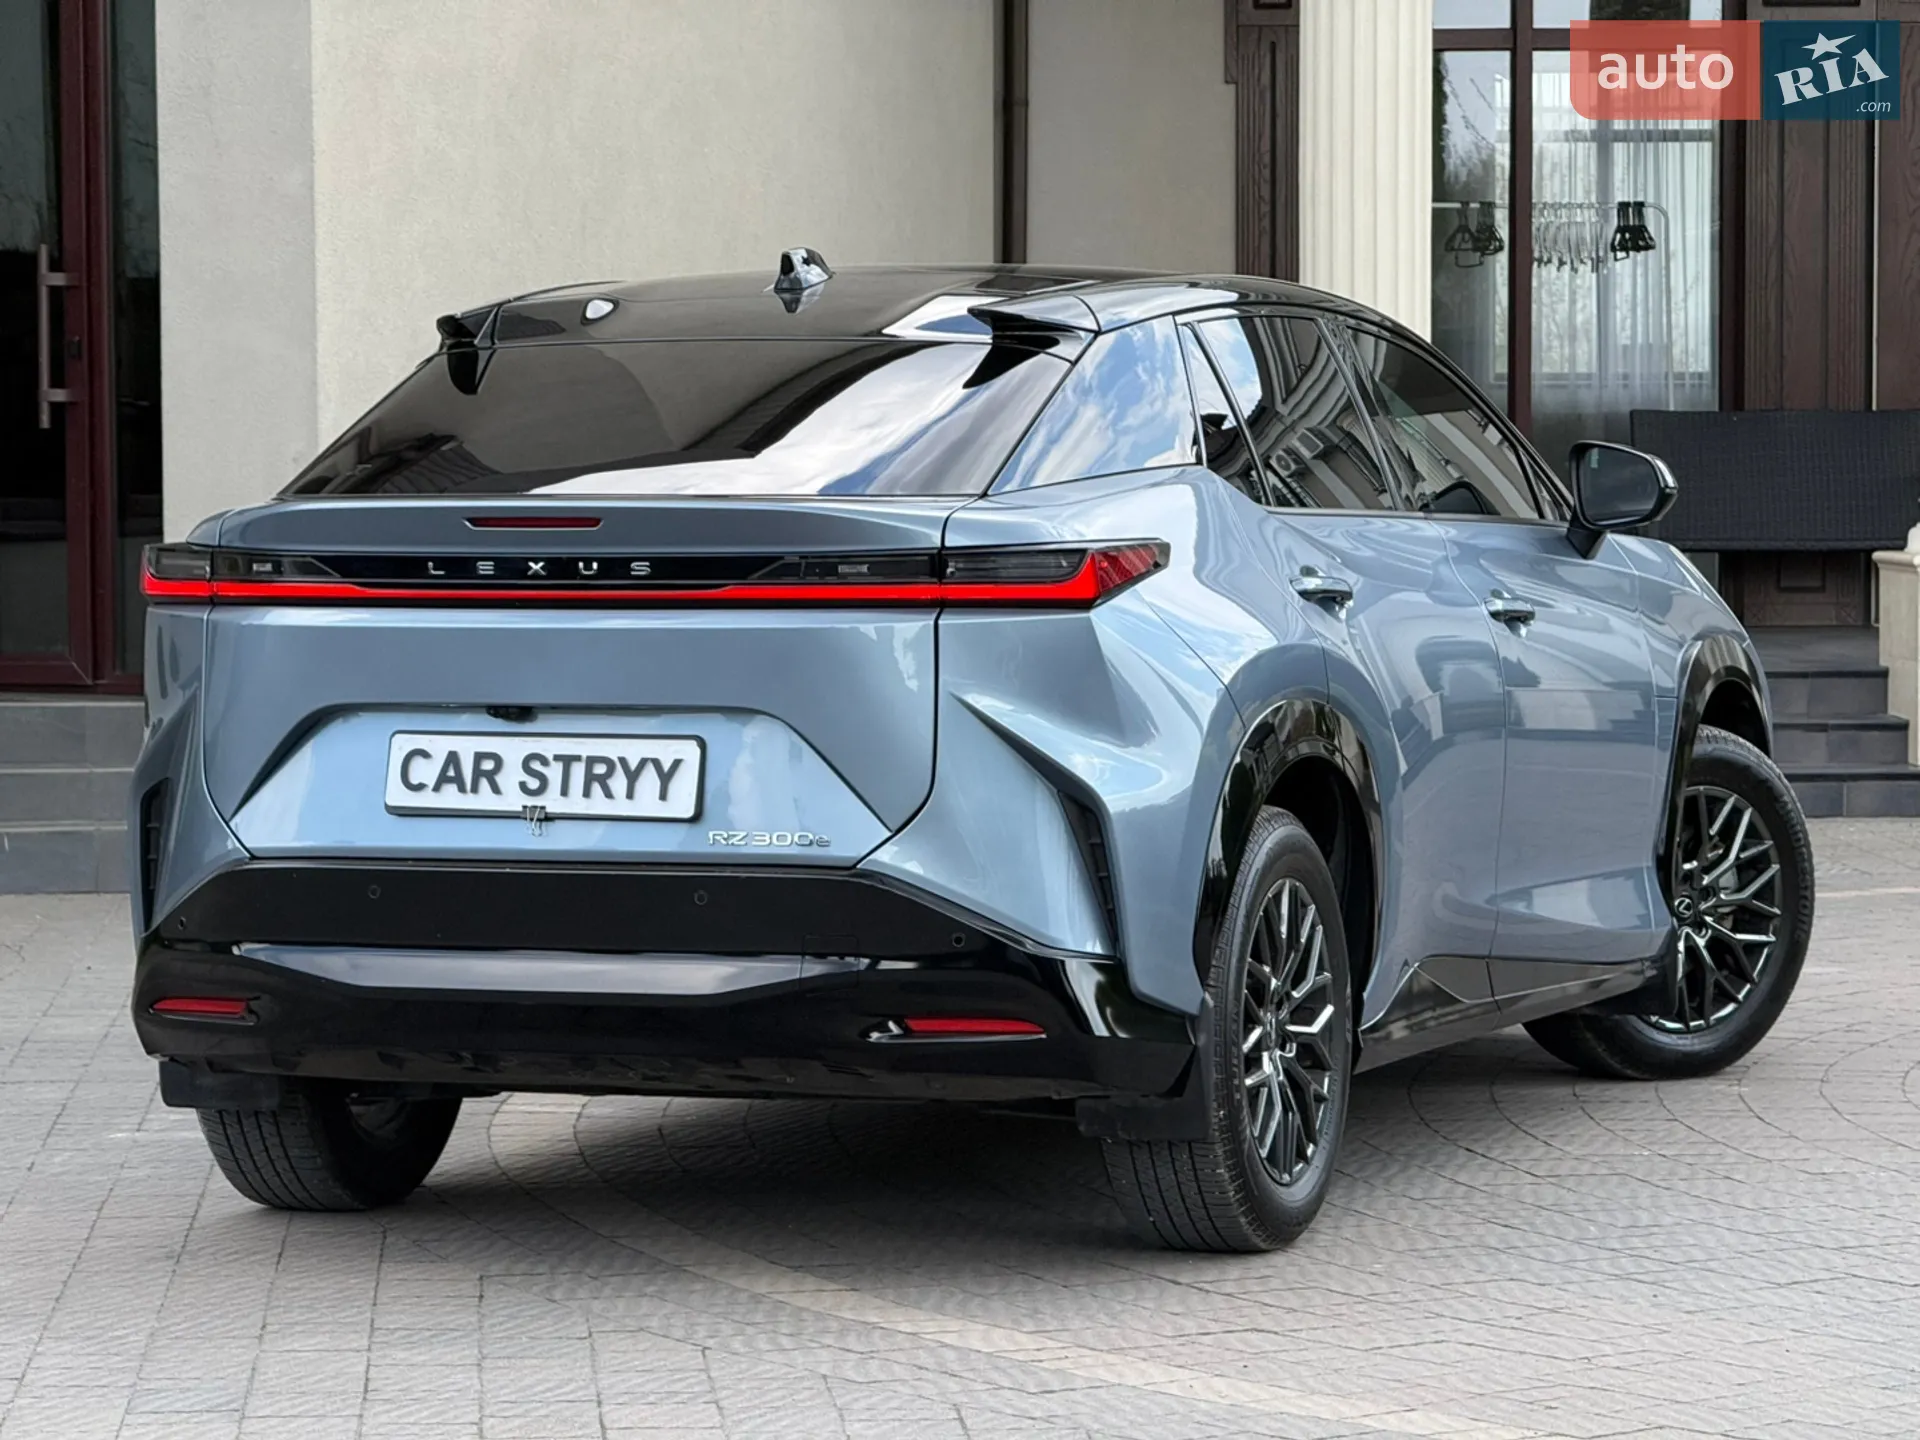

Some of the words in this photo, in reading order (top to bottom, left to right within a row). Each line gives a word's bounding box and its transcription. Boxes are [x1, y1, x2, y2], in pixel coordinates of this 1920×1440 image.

[428, 561, 651, 576] LEXUS
[400, 748, 504, 796] CAR
[518, 752, 685, 802] STRYY
